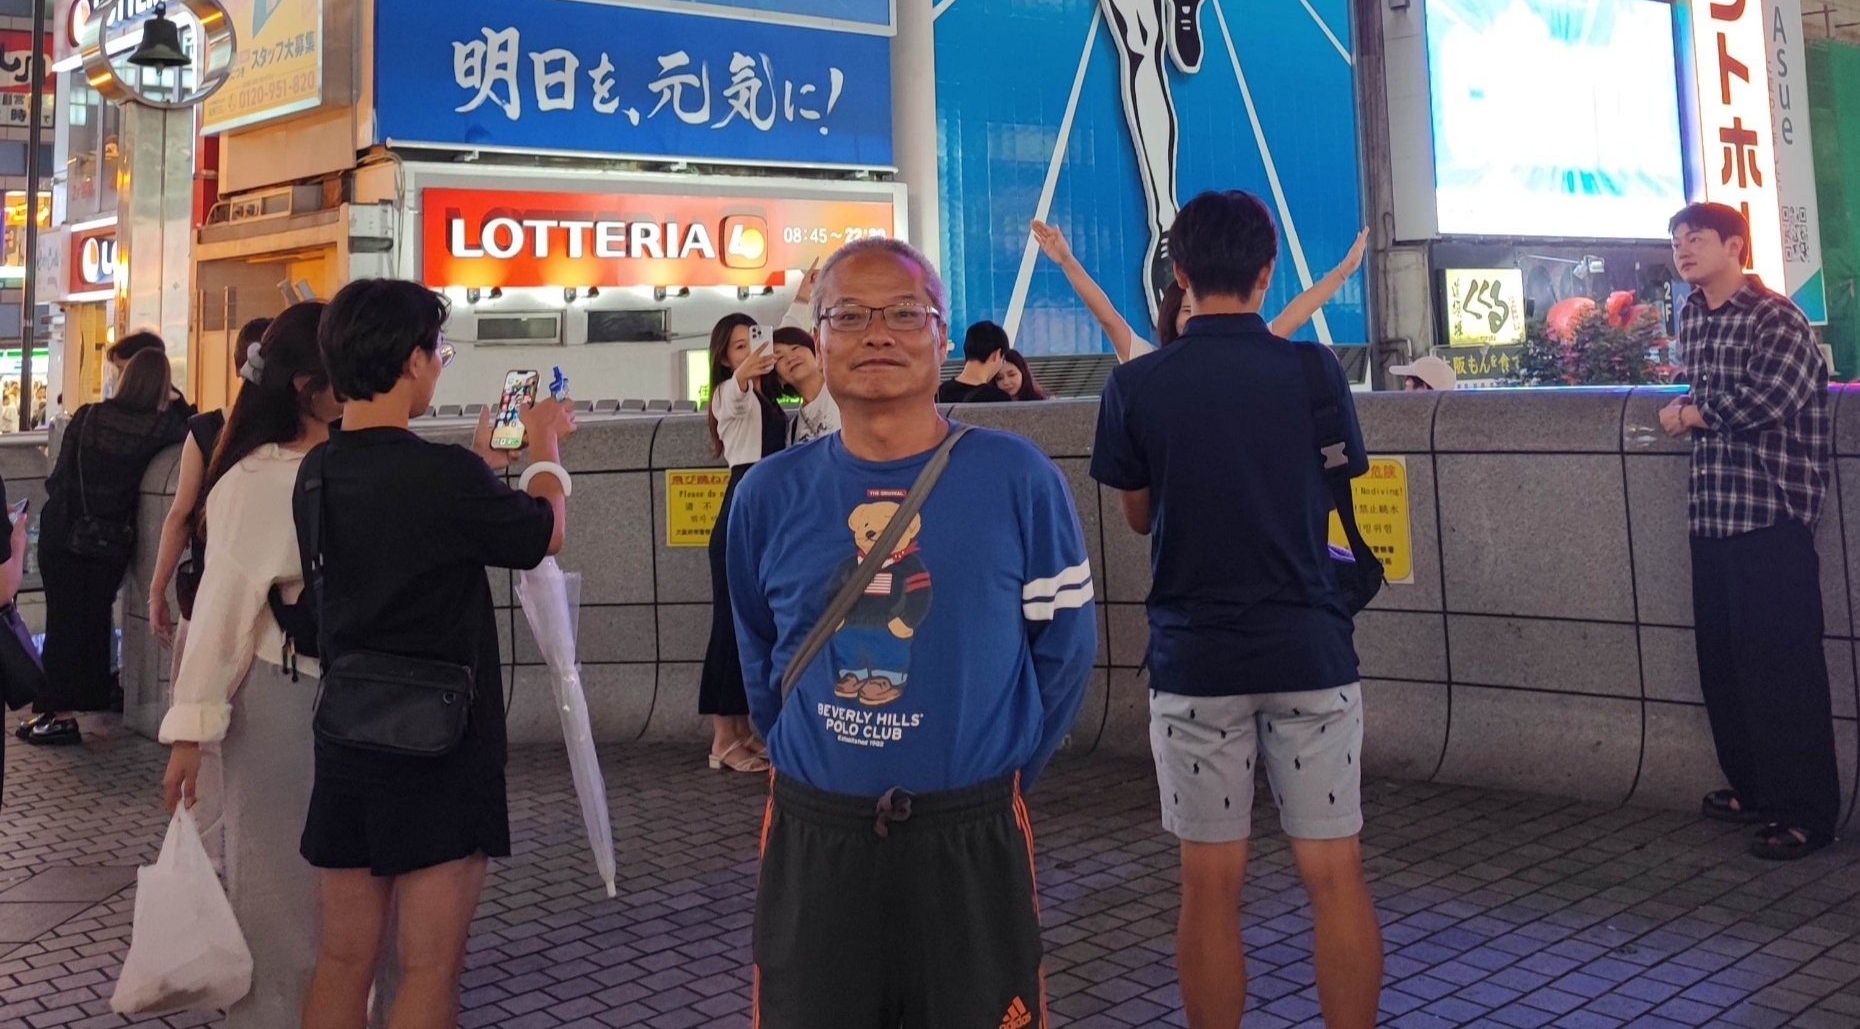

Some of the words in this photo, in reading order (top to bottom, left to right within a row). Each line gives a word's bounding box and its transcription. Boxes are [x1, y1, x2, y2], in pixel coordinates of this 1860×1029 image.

[251, 31, 316, 70] スタッフ大募集
[238, 72, 316, 110] 0120-951-820
[452, 27, 844, 135] 明日を、元気に!
[1772, 6, 1793, 145] Asue
[450, 217, 716, 259] LOTTERIA
[817, 702, 873, 725] BEVERLY
[826, 718, 859, 736] POLO
[862, 725, 903, 741] CLUB
